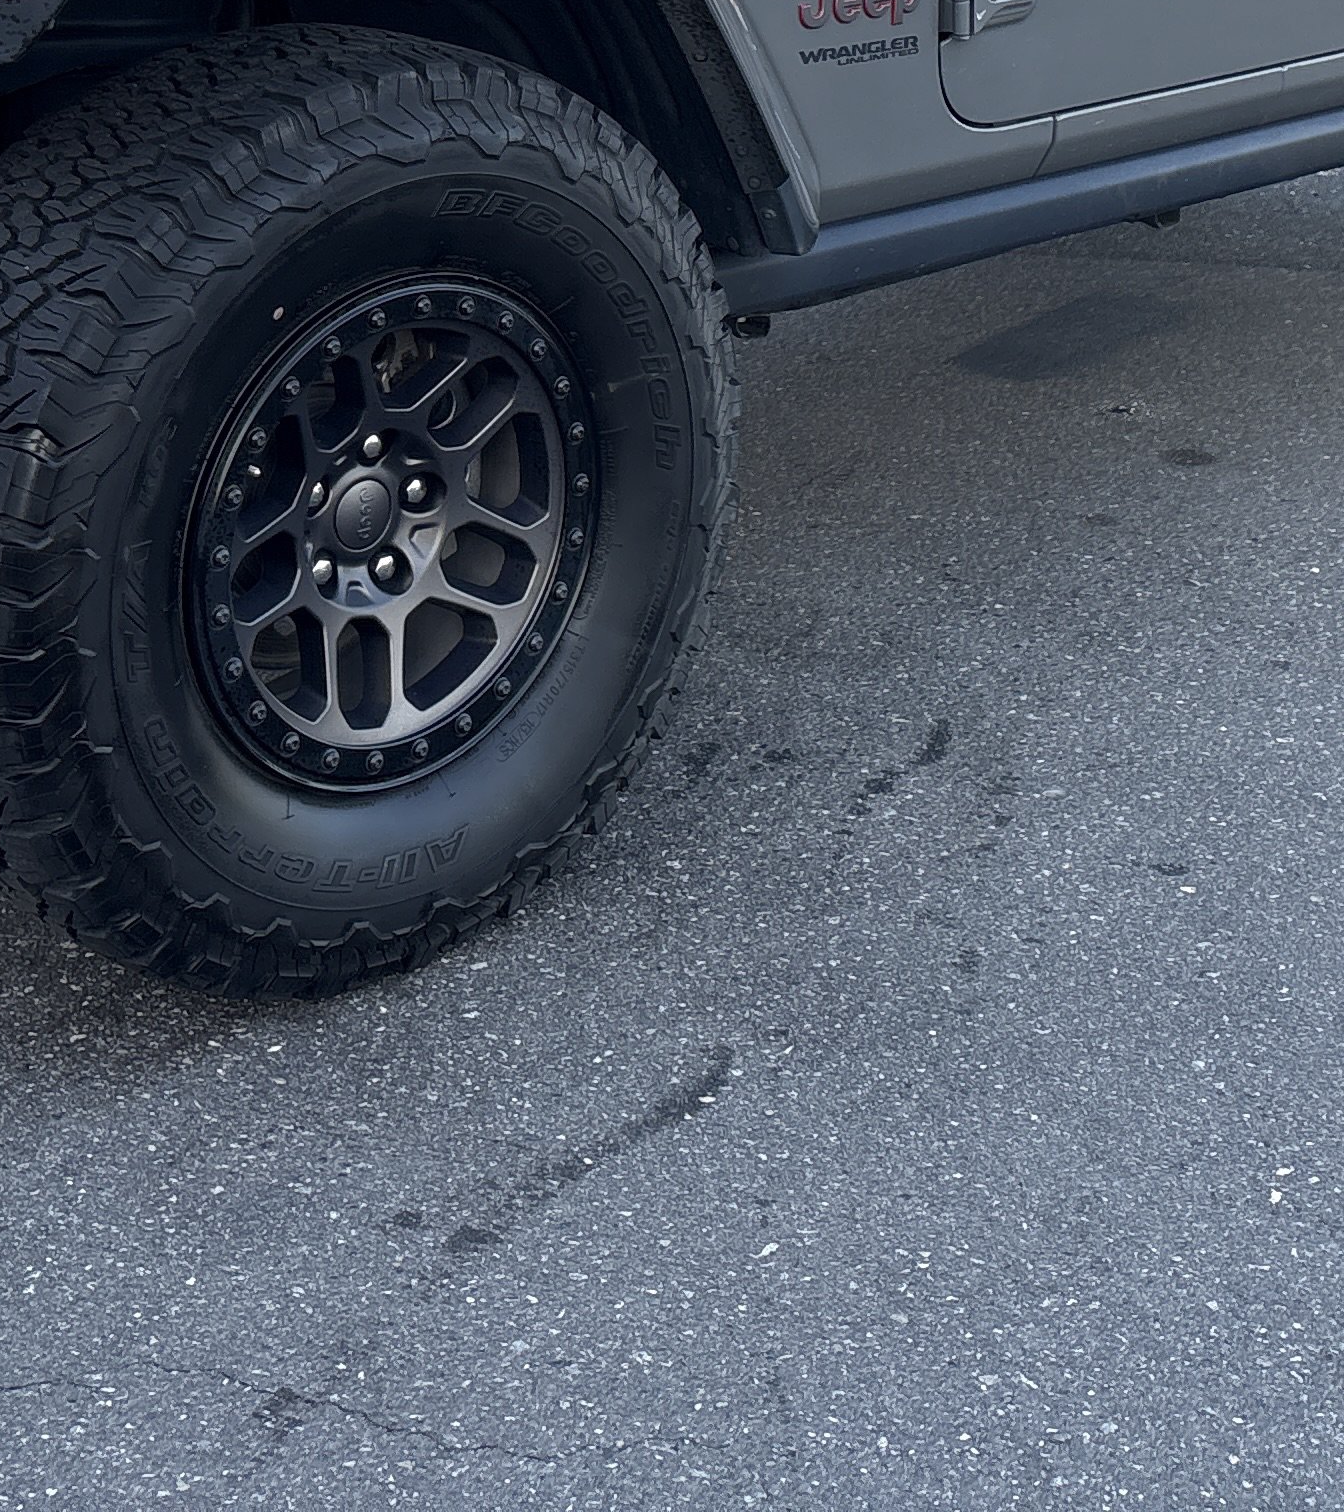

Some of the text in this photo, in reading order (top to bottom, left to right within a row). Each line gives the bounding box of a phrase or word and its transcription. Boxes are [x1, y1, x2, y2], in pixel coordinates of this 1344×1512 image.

[798, 35, 920, 65] WRANGLER
[837, 48, 920, 66] UNLIMITED
[431, 187, 683, 472] BFGoodrich
[356, 487, 375, 540] Jeep
[142, 717, 471, 894] All-Terrain
